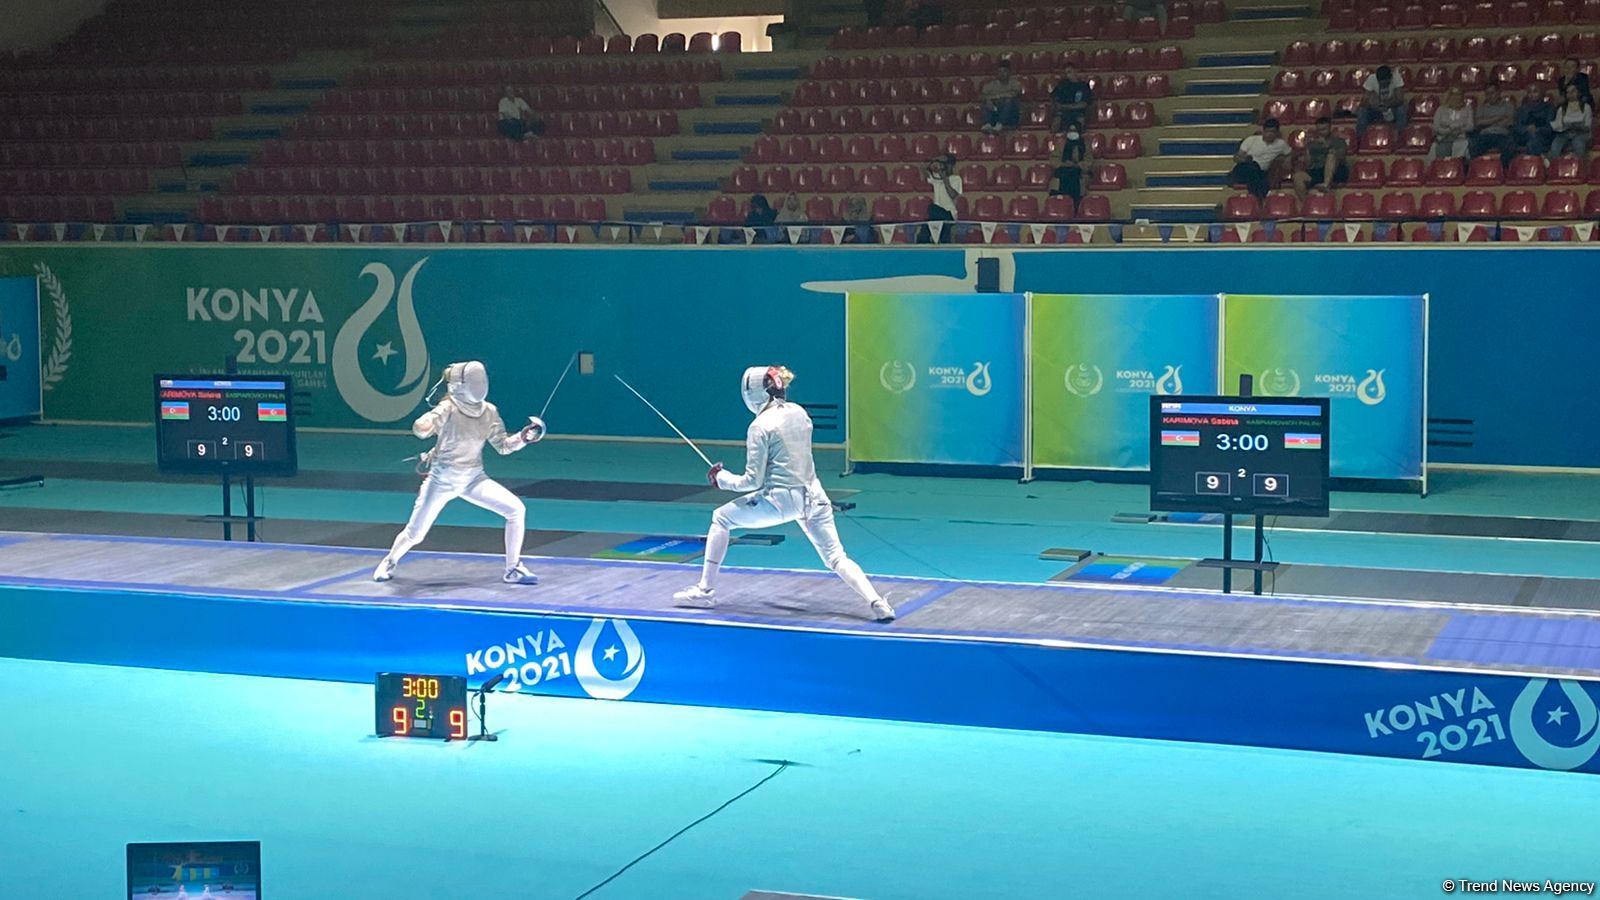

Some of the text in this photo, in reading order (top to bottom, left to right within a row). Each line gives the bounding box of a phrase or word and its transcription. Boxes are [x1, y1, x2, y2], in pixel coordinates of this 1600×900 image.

[187, 287, 324, 322] KONYA
[234, 329, 326, 364] 2021
[928, 367, 965, 376] KONYA
[1116, 370, 1155, 379] KONYA
[1314, 374, 1356, 383] KONYA
[941, 375, 966, 384] 2021
[1129, 379, 1156, 388] 2021
[1328, 383, 1358, 392] 2021
[207, 405, 241, 421] 3:00
[1228, 404, 1257, 412] KONYA
[1163, 417, 1209, 425] KARIMOVA
[222, 437, 228, 445] 2
[1216, 434, 1269, 450] 3:00
[197, 443, 206, 456] 9
[244, 444, 253, 457] 9
[1237, 468, 1246, 477] 2
[1206, 475, 1219, 489] 9
[1264, 477, 1278, 491] 9
[466, 629, 566, 676] KONYA
[502, 652, 572, 692] 2021
[402, 678, 439, 698] 3:00
[415, 699, 426, 719] 2
[1364, 686, 1496, 739] KONYA
[393, 707, 407, 735] 9
[449, 710, 464, 737] 9
[1416, 714, 1506, 759] 2021
